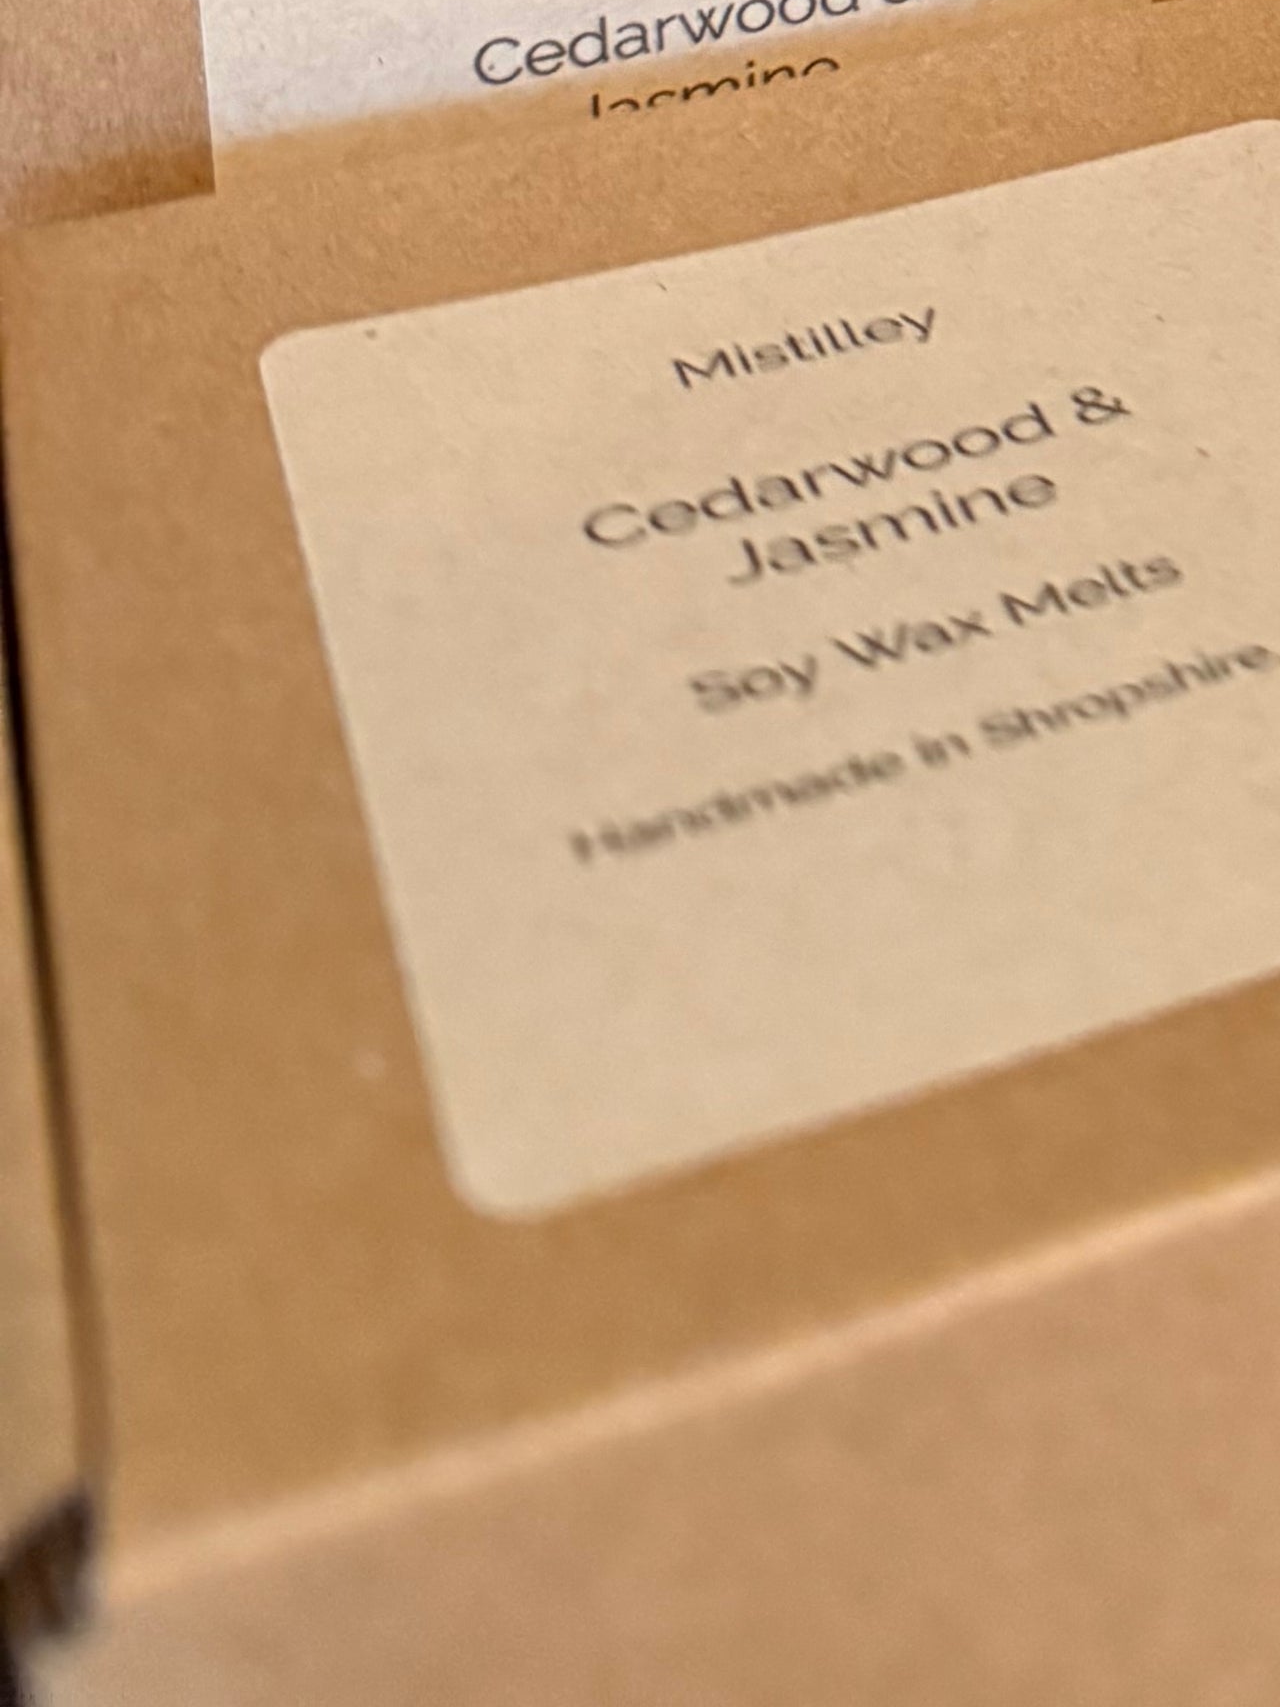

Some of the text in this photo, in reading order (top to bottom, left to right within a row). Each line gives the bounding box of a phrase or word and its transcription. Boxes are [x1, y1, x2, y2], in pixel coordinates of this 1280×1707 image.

[672, 305, 939, 391] Mistilley
[581, 384, 1134, 551] Cedarwood &
[727, 469, 1060, 587] Jasmine
[688, 554, 1186, 714] Soy Wax Melts
[566, 747, 908, 868] Handmade
[913, 727, 975, 768] in
